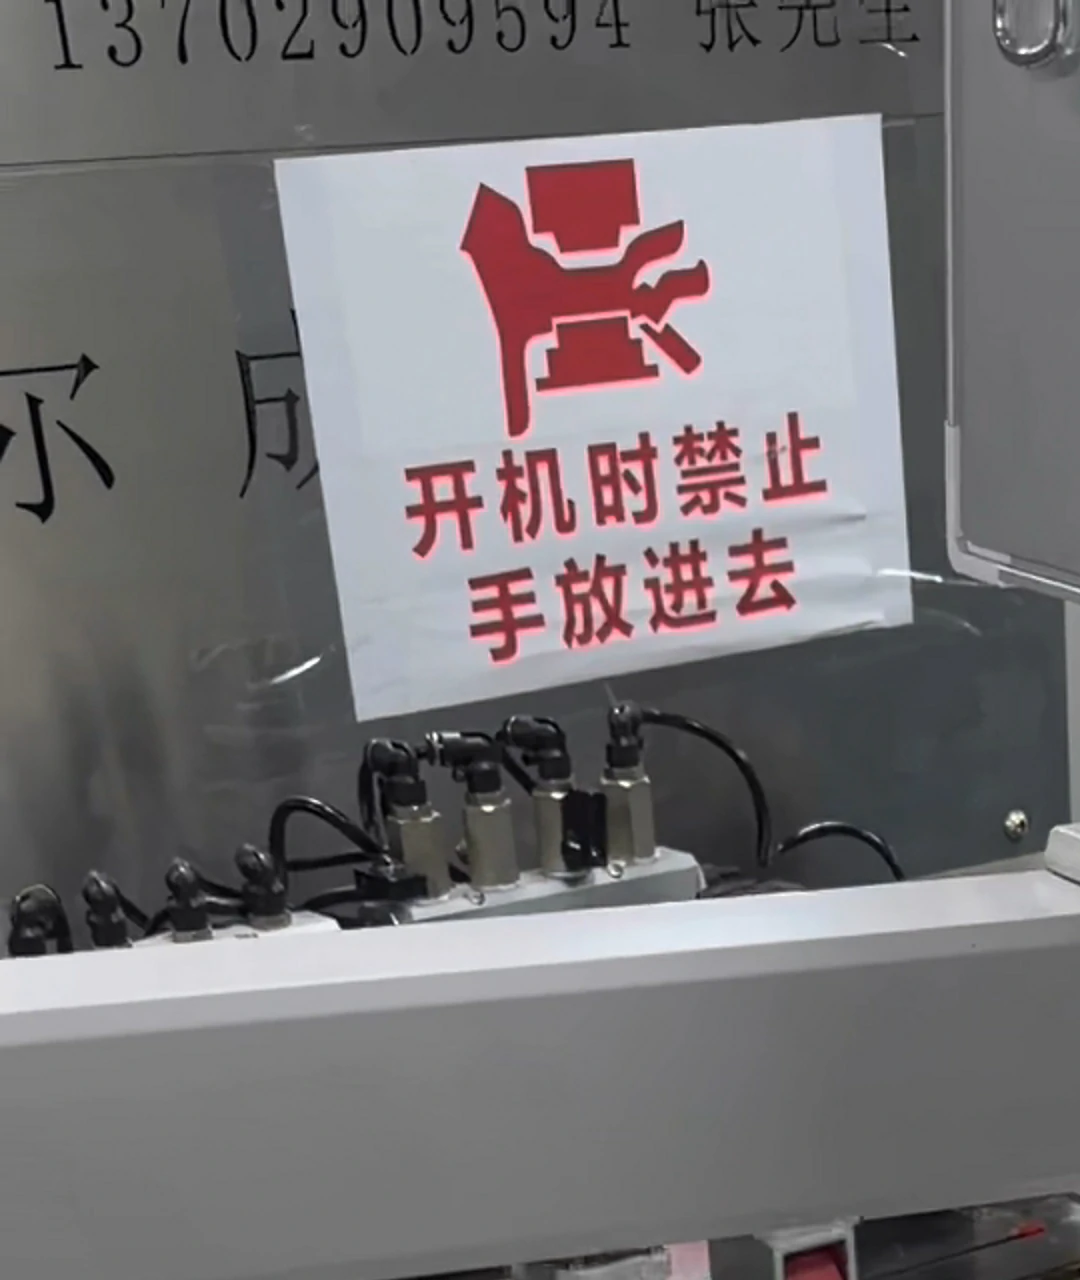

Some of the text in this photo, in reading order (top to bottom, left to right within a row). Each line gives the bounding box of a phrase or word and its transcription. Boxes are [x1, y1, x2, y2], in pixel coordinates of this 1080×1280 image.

[44, 0, 632, 70] 13702909594
[403, 411, 828, 559] 开机时禁止
[467, 527, 797, 664] 手放进去
